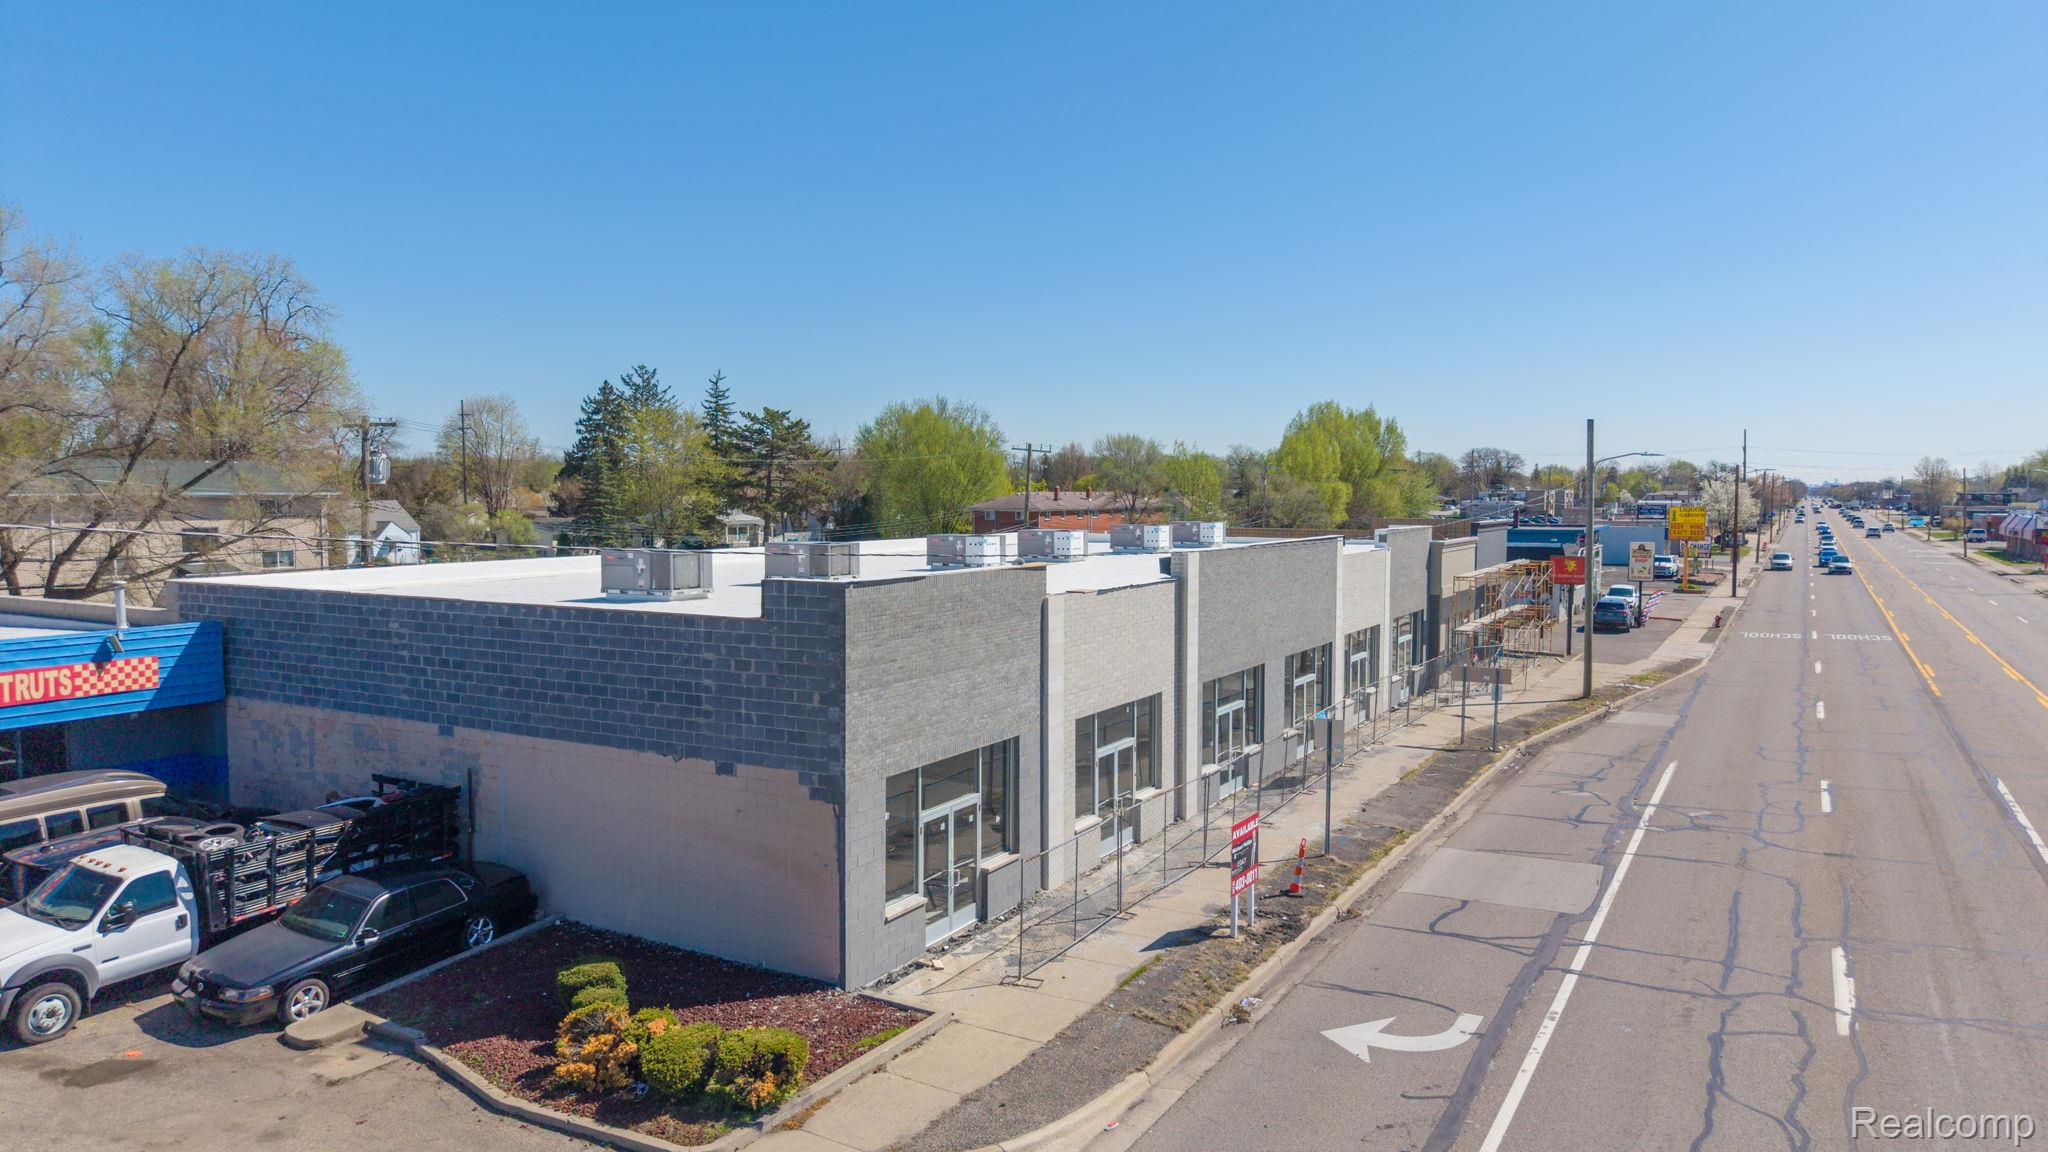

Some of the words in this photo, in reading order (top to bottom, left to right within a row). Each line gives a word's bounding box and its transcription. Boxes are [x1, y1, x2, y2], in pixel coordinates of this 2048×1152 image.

[1739, 631, 1803, 639] SCHOOL
[1825, 633, 1893, 641] SCHOOL
[0, 668, 73, 703] TRUTS
[1232, 818, 1259, 840] AVAILABLE
